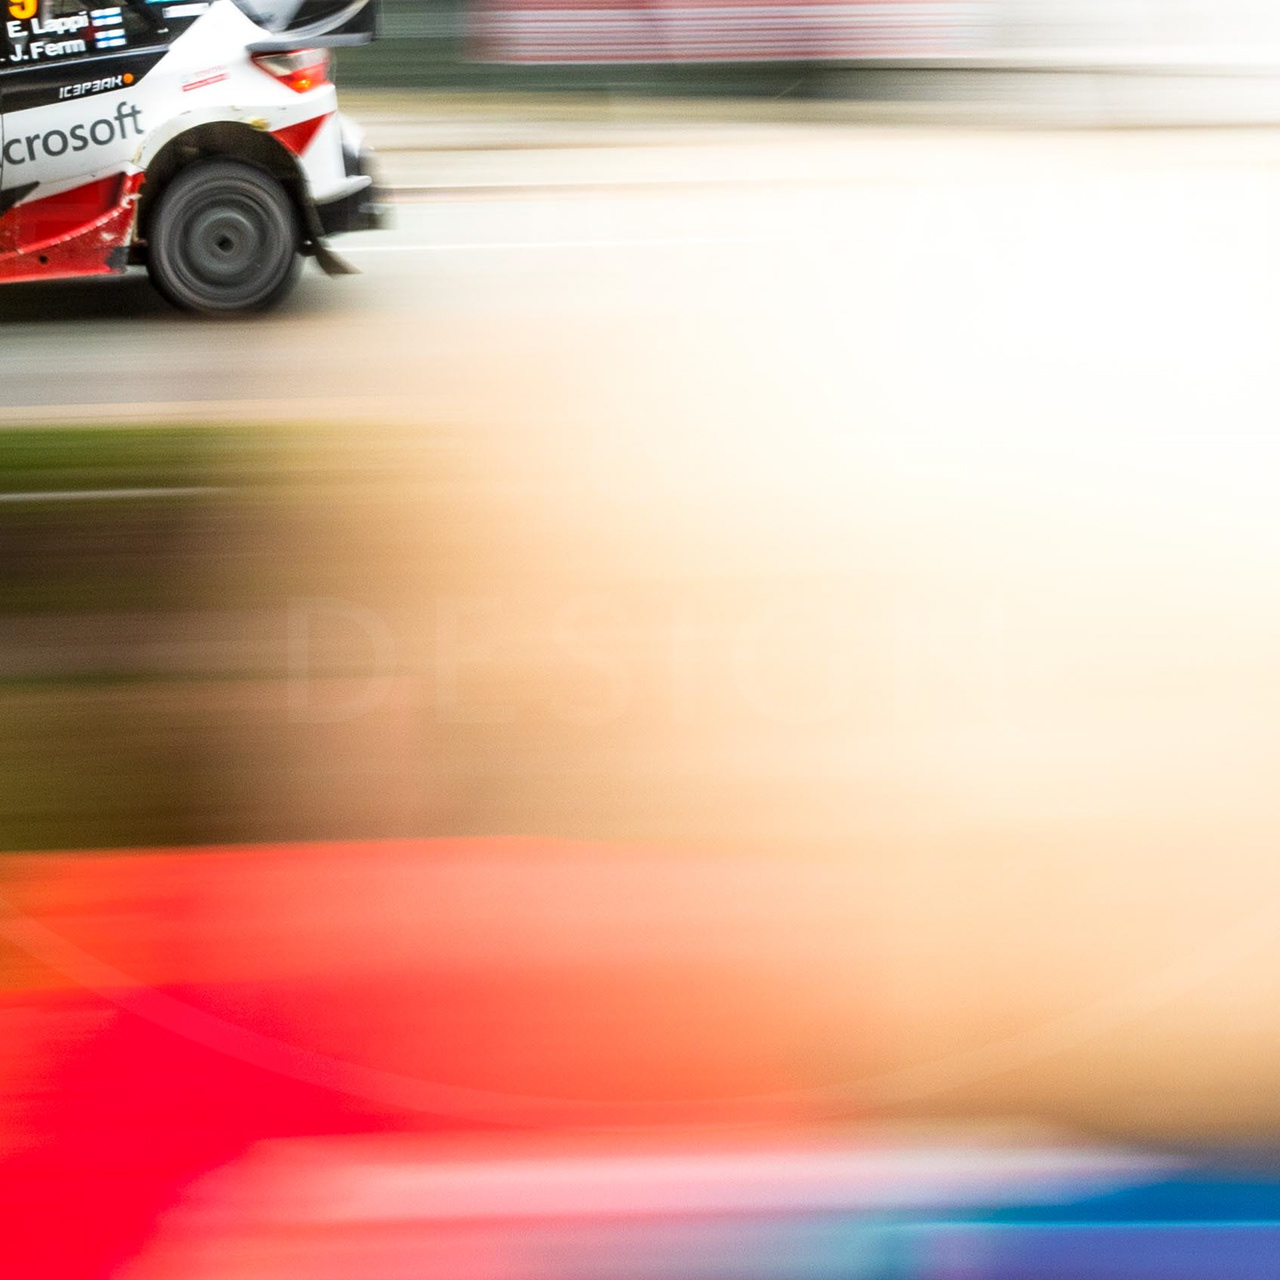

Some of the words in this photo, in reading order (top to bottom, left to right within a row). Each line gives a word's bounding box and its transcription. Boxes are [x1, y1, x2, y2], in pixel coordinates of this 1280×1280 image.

[6, 20, 29, 39] E.
[30, 11, 90, 35] Lappi
[9, 43, 30, 62] J.
[30, 38, 87, 60] Ferm
